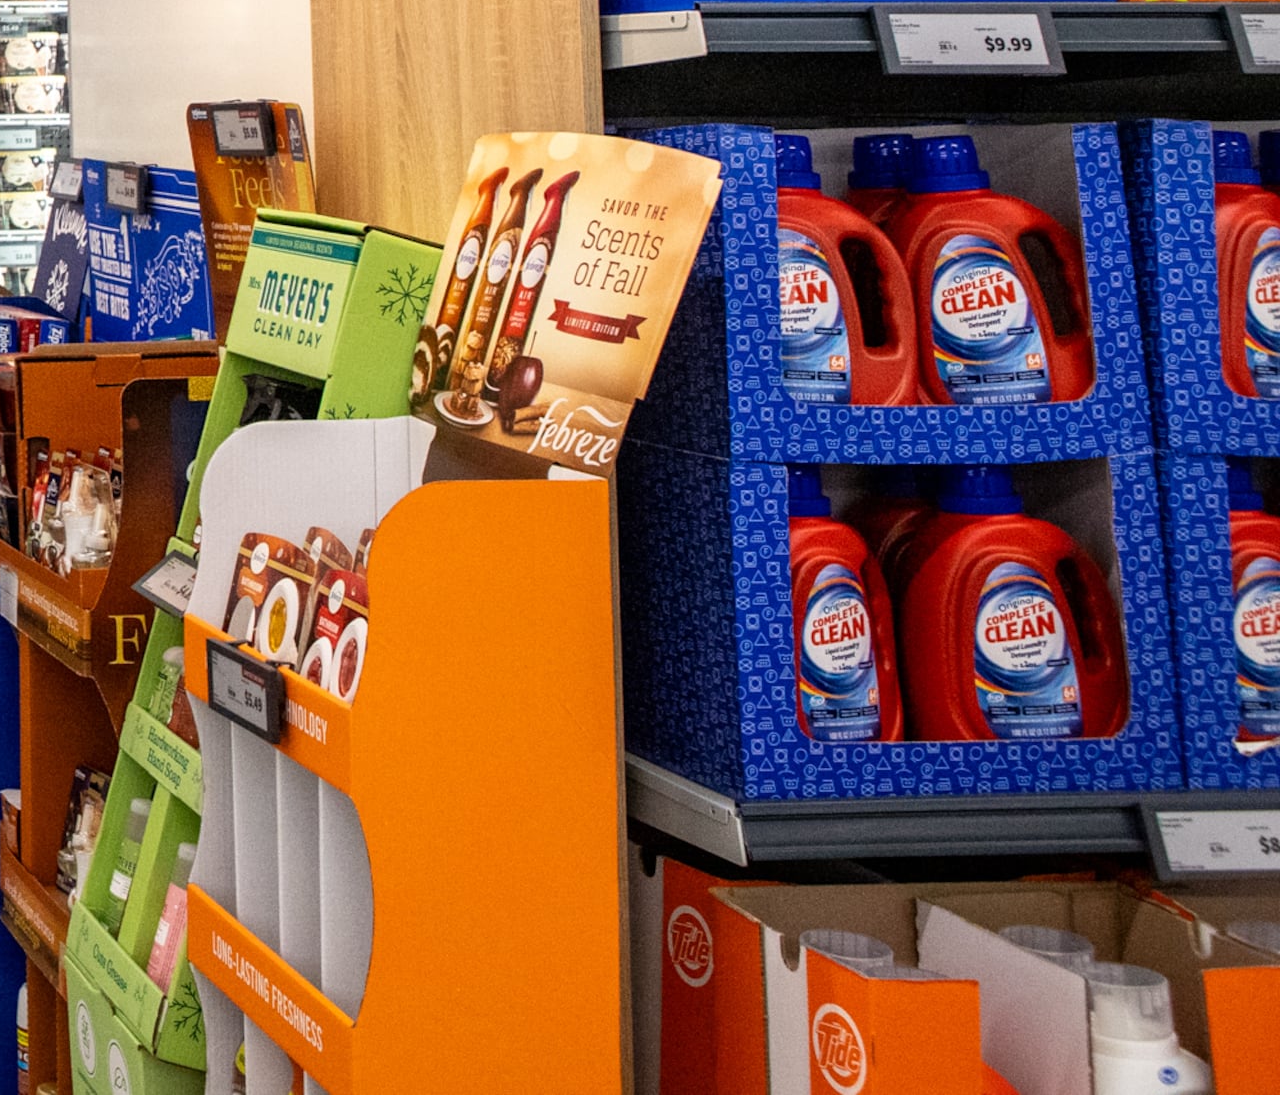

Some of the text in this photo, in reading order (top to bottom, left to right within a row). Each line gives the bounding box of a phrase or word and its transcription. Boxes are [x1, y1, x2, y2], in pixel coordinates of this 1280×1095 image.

[984, 36, 1032, 53] $9.99
[243, 126, 258, 139] $5.99
[230, 168, 286, 210] Feels
[601, 198, 668, 221] SAVOR THE
[52, 202, 88, 249] Kleenex
[102, 232, 117, 258] THE
[294, 239, 315, 250] SEASONAL
[581, 219, 664, 261] Scents
[453, 281, 466, 290] AIR
[573, 256, 648, 296] of Fall
[942, 272, 1005, 297] COMPLETE
[953, 267, 991, 284] Original
[248, 270, 334, 326] Mrs. MEYER'S
[485, 286, 498, 295] AIR
[518, 290, 532, 300] AIR
[780, 281, 828, 305] EAN
[941, 281, 1016, 315] CLEAN
[790, 307, 817, 316] Laundry
[959, 309, 1007, 323] Liquid Laundry
[48, 323, 65, 345] Zip
[253, 318, 322, 349] CLEAN DAY
[564, 316, 620, 336] LIMITED EDITION
[968, 319, 1001, 328] Detergent
[831, 357, 844, 367] 64
[1028, 355, 1040, 365] 64
[527, 398, 617, 466] febreze
[823, 600, 851, 615] Original
[986, 602, 1046, 625] COMPLETE
[998, 596, 1034, 612] Original
[812, 604, 859, 628] COMPLETE
[984, 612, 1056, 643] CLEAN
[811, 614, 865, 646] CLEAN
[1010, 650, 1041, 659] Detergent
[1020, 640, 1048, 650] Laundry
[244, 690, 263, 713] $5.49
[1064, 688, 1075, 699] 64
[148, 726, 189, 771] Hardworking
[147, 749, 182, 789] Hand Soap
[672, 921, 710, 966] Tide
[211, 931, 270, 1003] LONG-LASTING
[272, 983, 323, 1052] FRESHNESS
[816, 1021, 861, 1073] Tide
